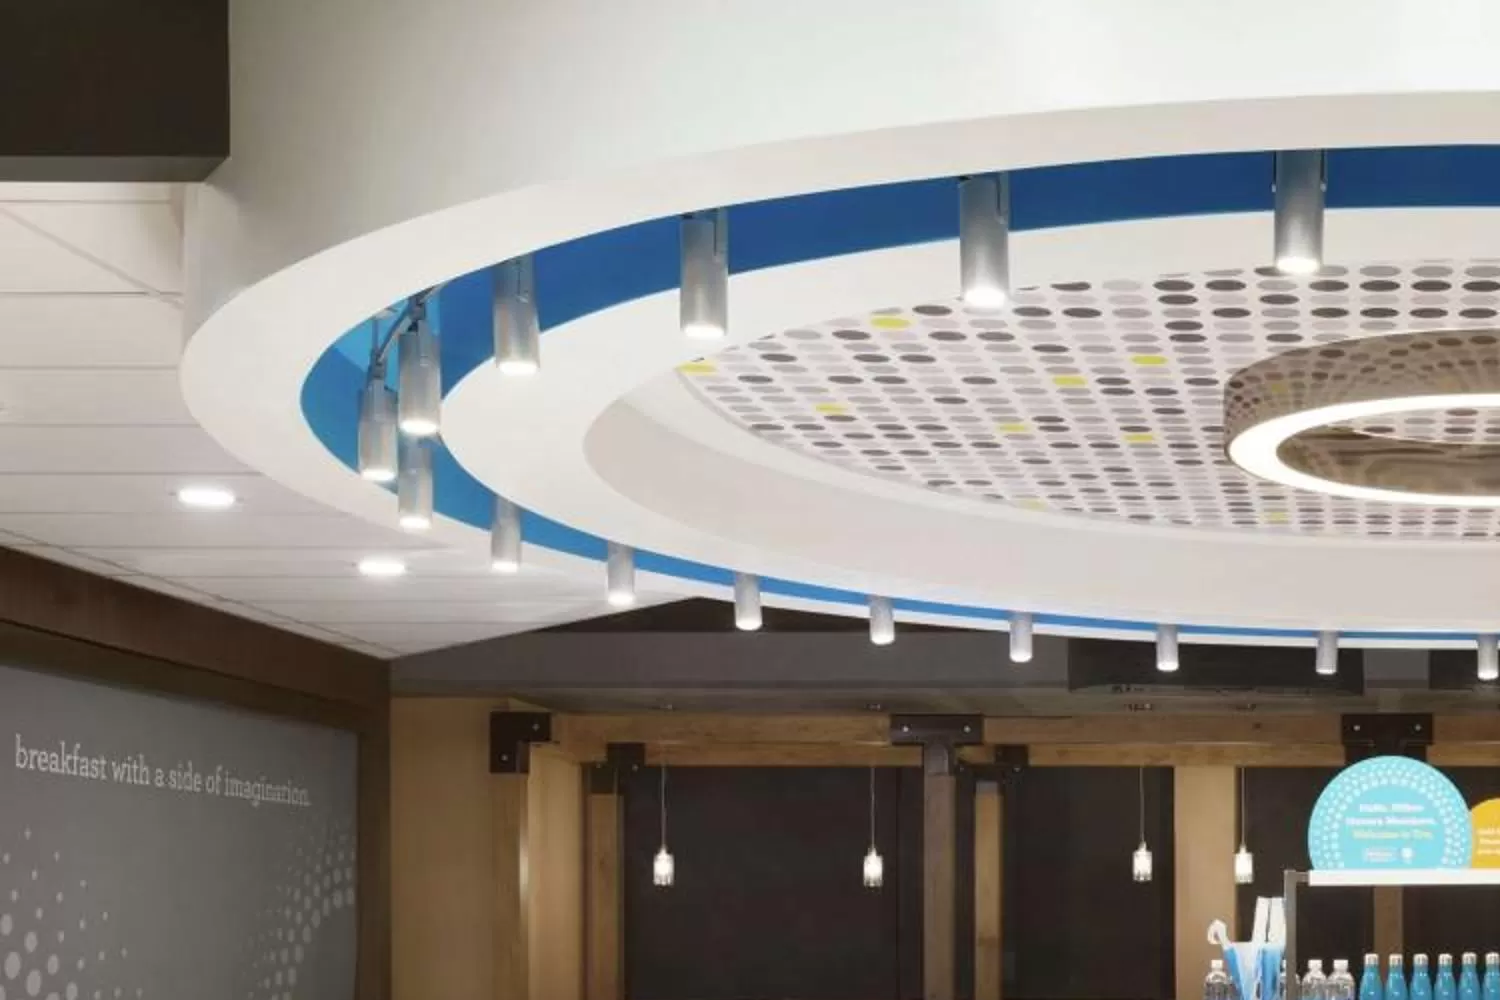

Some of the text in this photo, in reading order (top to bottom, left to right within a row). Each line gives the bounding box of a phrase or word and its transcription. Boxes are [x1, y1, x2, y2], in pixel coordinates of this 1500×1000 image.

[15, 733, 107, 780] breakfast
[111, 753, 150, 786] with
[155, 766, 165, 788] a
[168, 761, 203, 793] side
[205, 764, 223, 796] of
